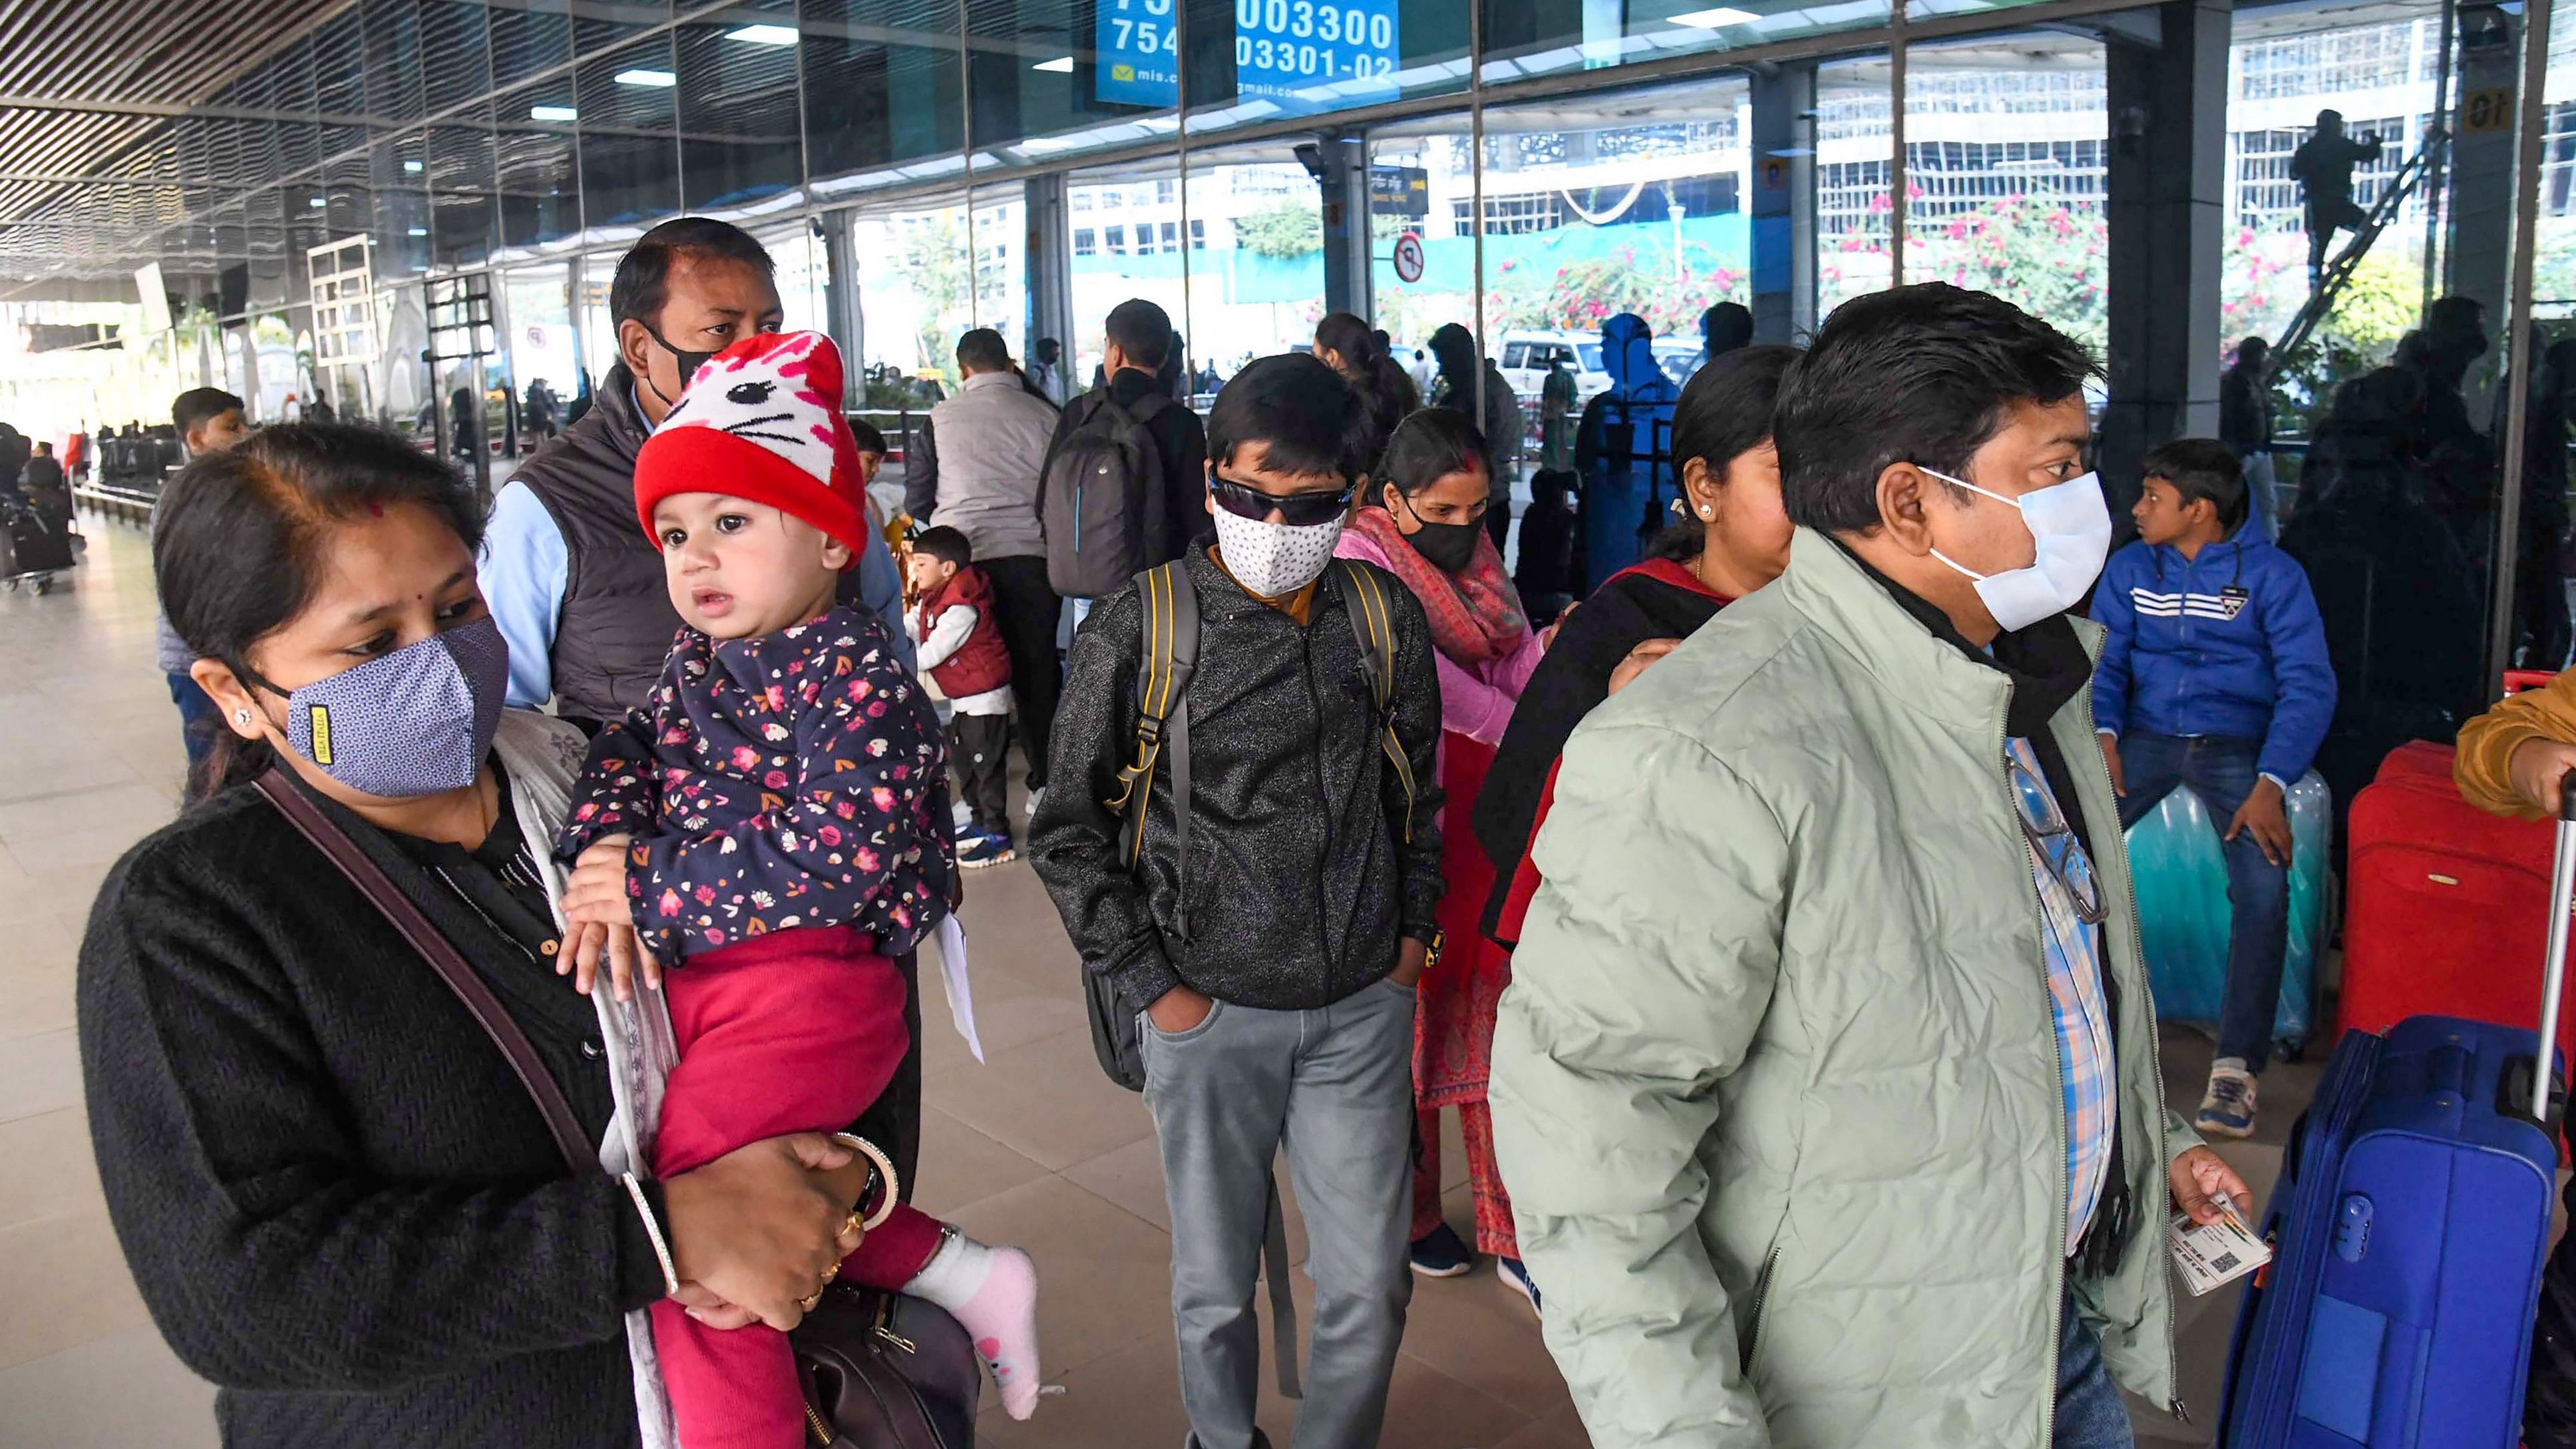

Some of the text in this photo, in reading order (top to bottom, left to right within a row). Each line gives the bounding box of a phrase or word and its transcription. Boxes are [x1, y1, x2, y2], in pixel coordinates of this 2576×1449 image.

[1111, 18, 1391, 84] 754 03301-02
[1236, 0, 1391, 49] 003300
